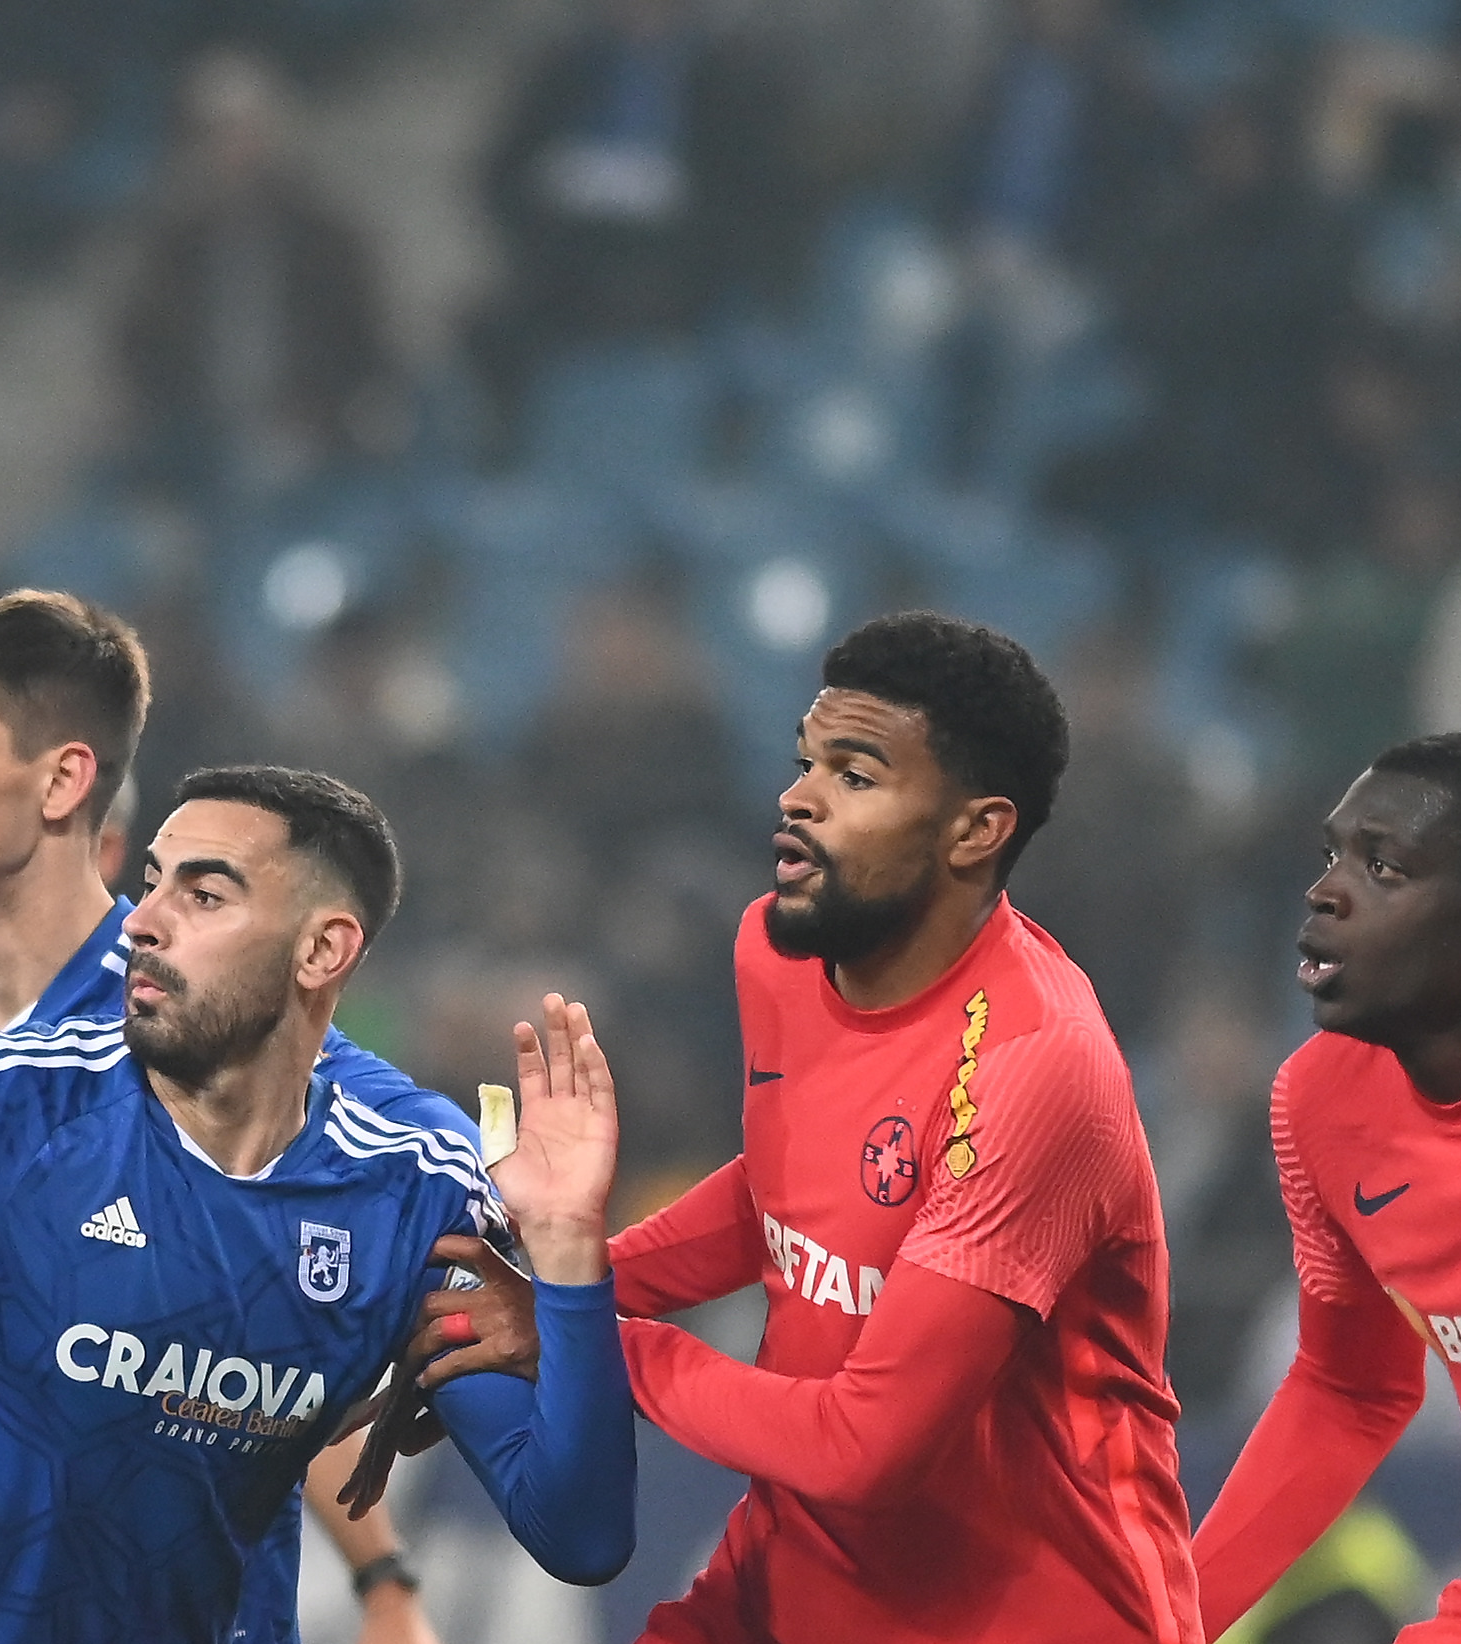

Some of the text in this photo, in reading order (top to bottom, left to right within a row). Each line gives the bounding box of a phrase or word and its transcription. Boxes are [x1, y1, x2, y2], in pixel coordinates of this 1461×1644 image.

[80, 1221, 148, 1249] adidas
[55, 1322, 327, 1422] CRAIOVA
[161, 1389, 243, 1431] Cetatea
[153, 1420, 219, 1446] GRAND
